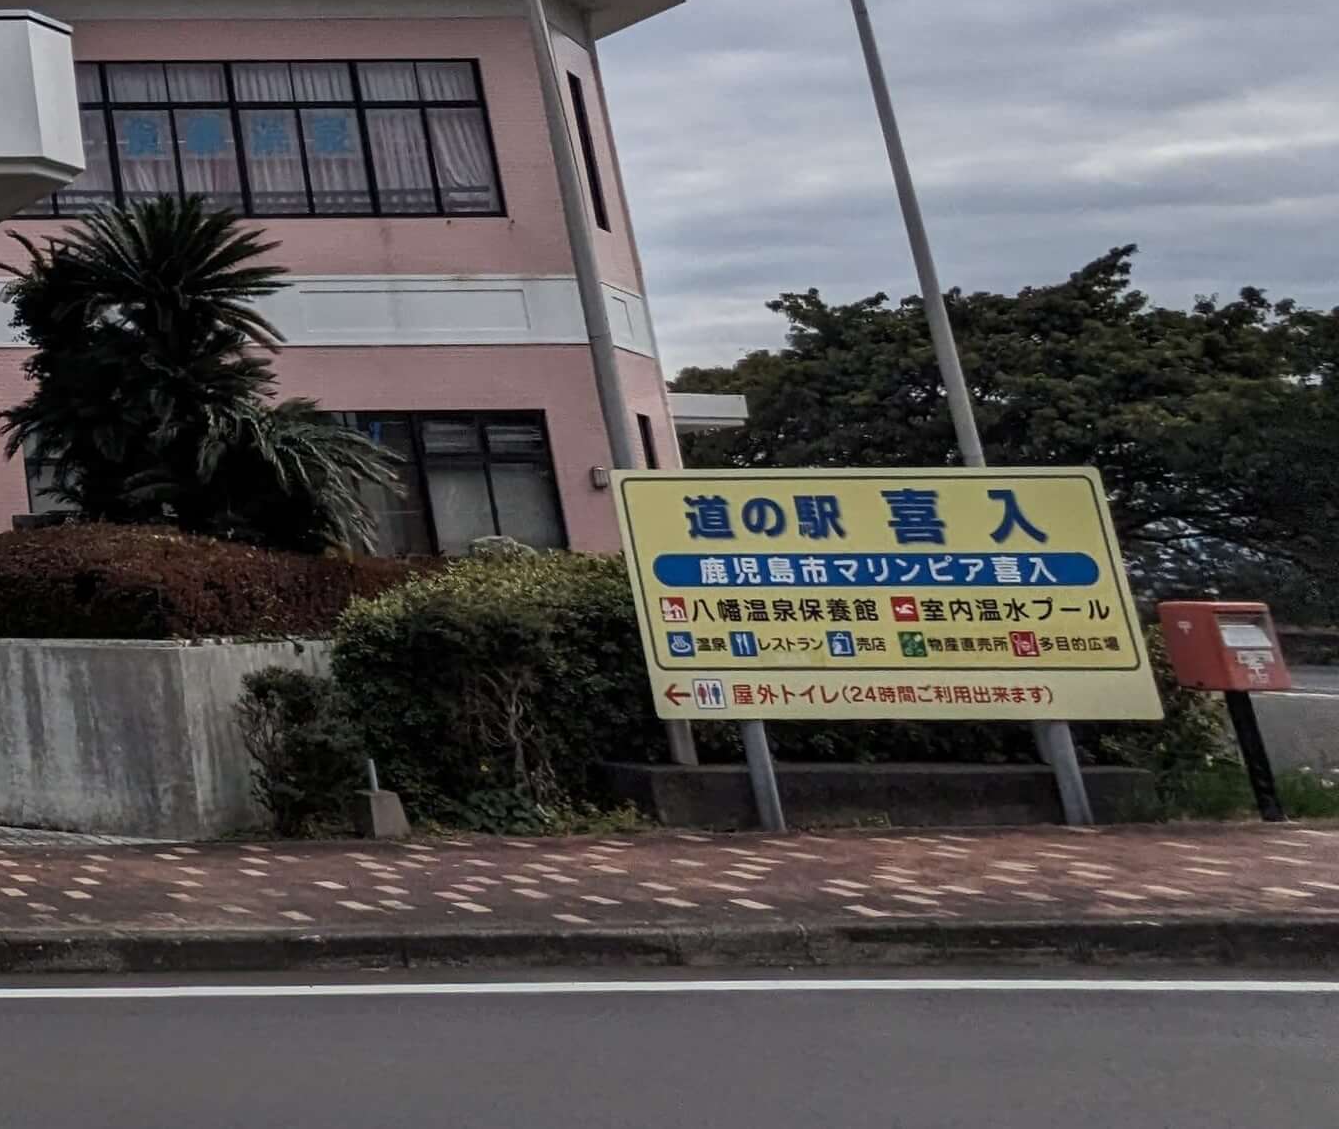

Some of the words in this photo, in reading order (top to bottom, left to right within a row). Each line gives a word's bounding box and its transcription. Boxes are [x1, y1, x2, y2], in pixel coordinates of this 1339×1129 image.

[683, 494, 846, 540] 道の駅
[699, 556, 1058, 584] 鹿児島市マリンピア喜入
[692, 598, 880, 622] 八幡温泉保養館
[920, 598, 1110, 622] 室内温水プール
[695, 637, 729, 652] 温泉
[757, 636, 823, 652] レストラン
[856, 637, 887, 652] 売店
[927, 636, 1009, 652] 物産直売所
[1039, 636, 1120, 652] 多目的広場
